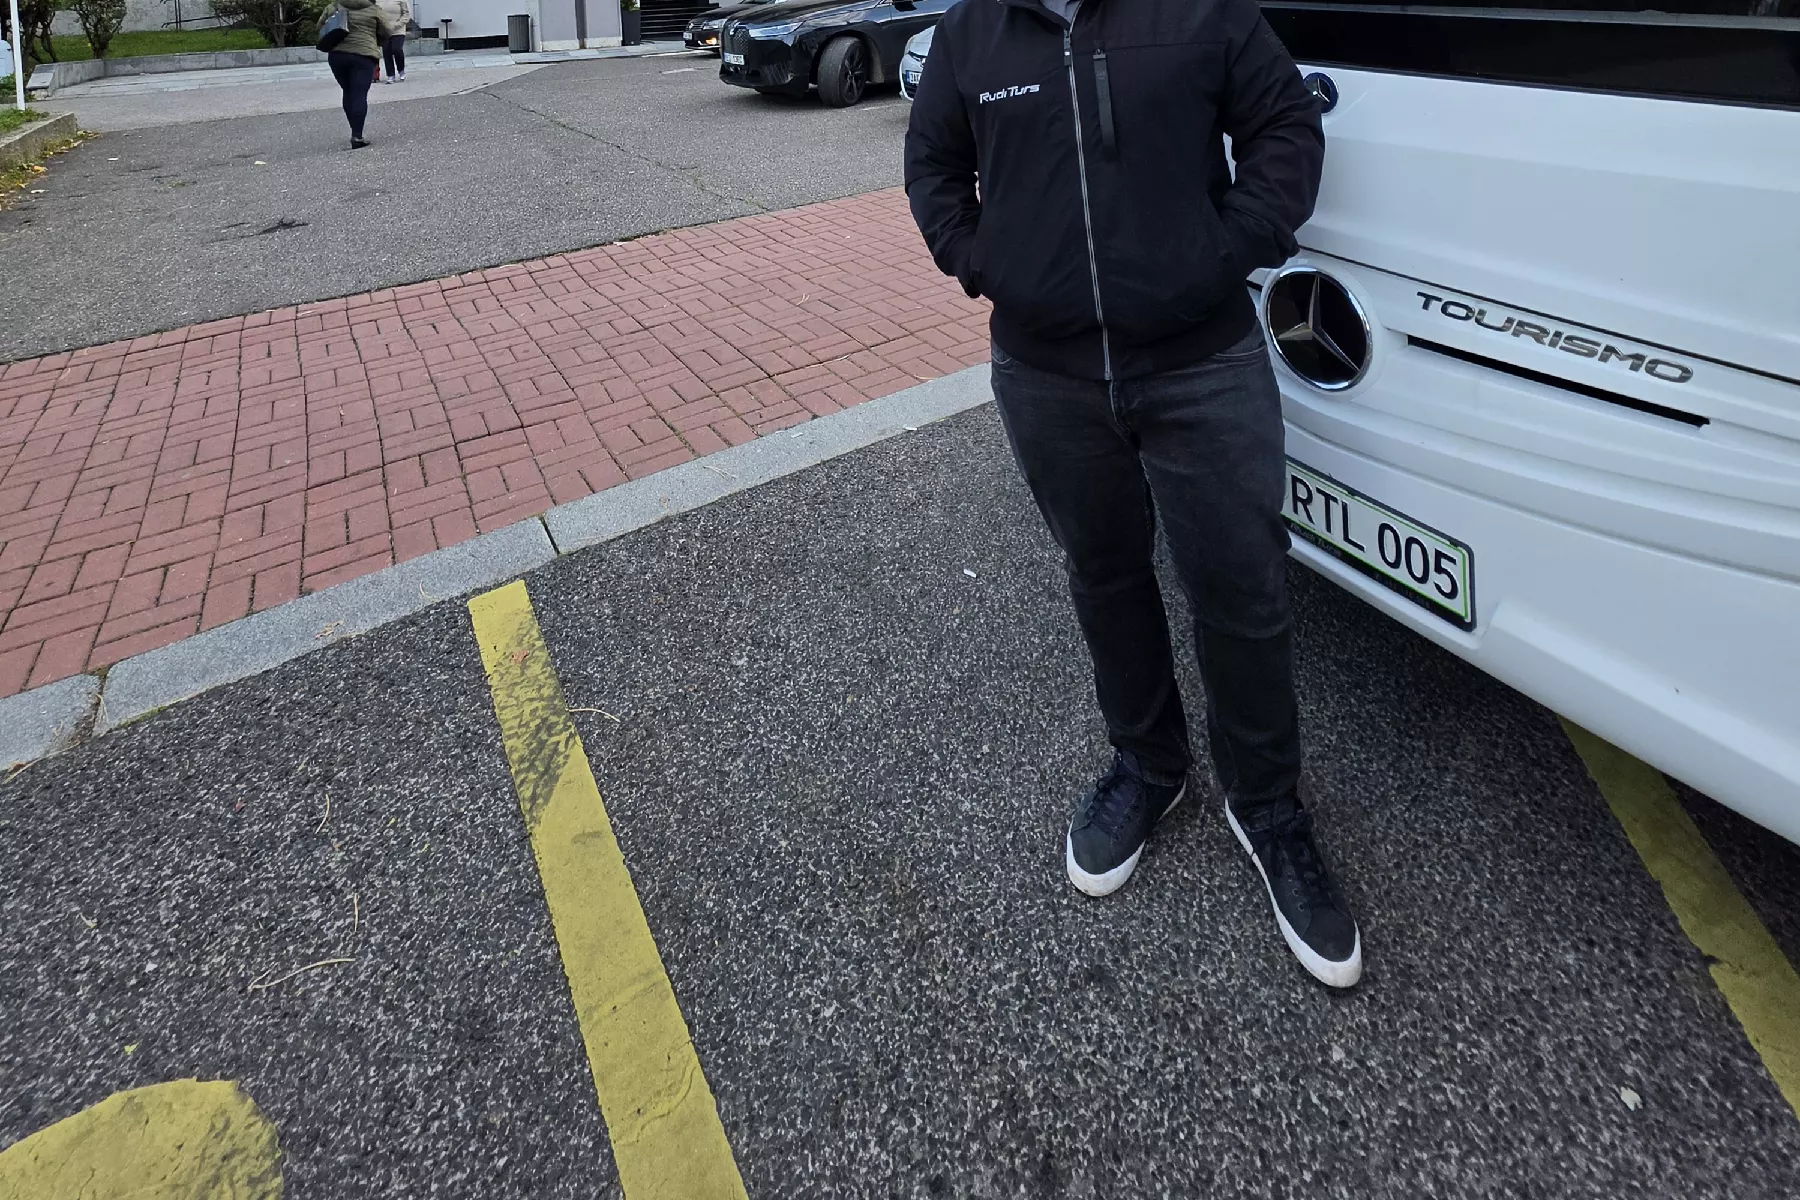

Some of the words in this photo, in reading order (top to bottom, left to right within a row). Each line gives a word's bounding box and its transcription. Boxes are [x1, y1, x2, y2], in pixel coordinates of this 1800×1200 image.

[1416, 291, 1694, 384] TOURISMO
[1291, 474, 1367, 554] RTL
[1377, 521, 1459, 601] 005
